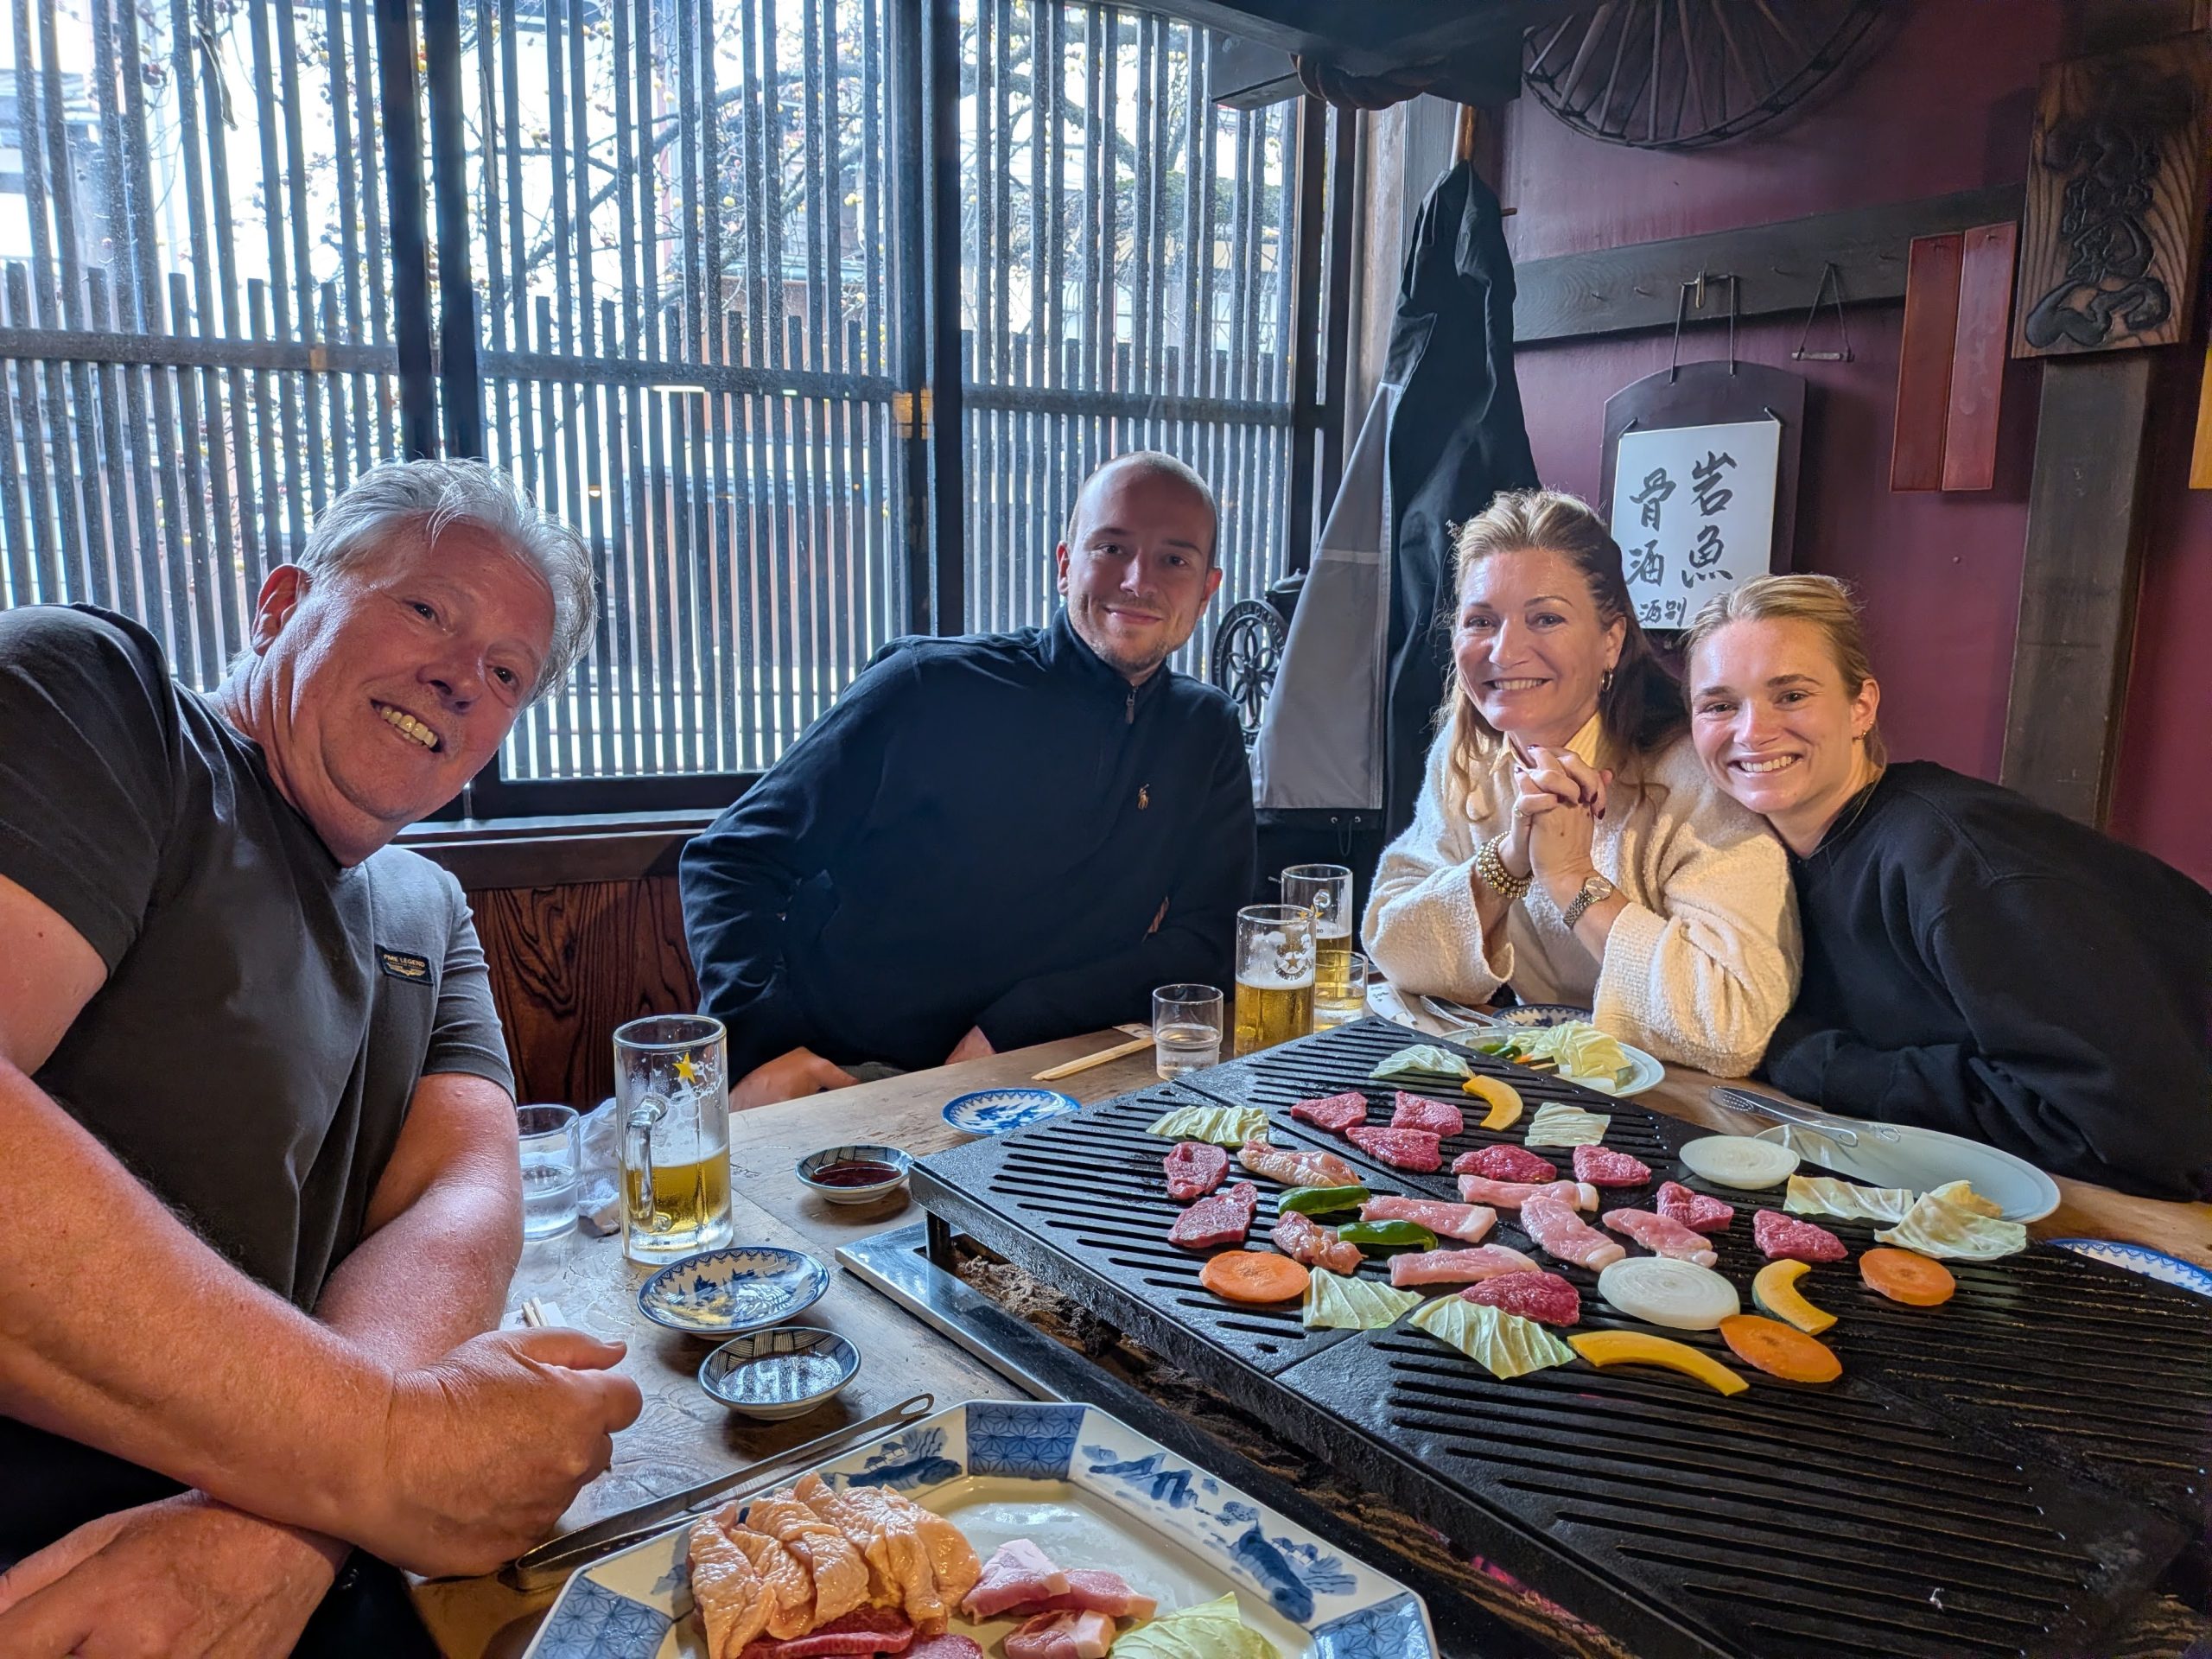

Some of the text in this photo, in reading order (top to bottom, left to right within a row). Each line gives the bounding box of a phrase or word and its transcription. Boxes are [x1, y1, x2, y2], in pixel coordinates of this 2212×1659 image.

[1625, 467, 1677, 588] 骨酒
[1681, 450, 1738, 589] 岩魚
[399, 957, 425, 968] LEGEND
